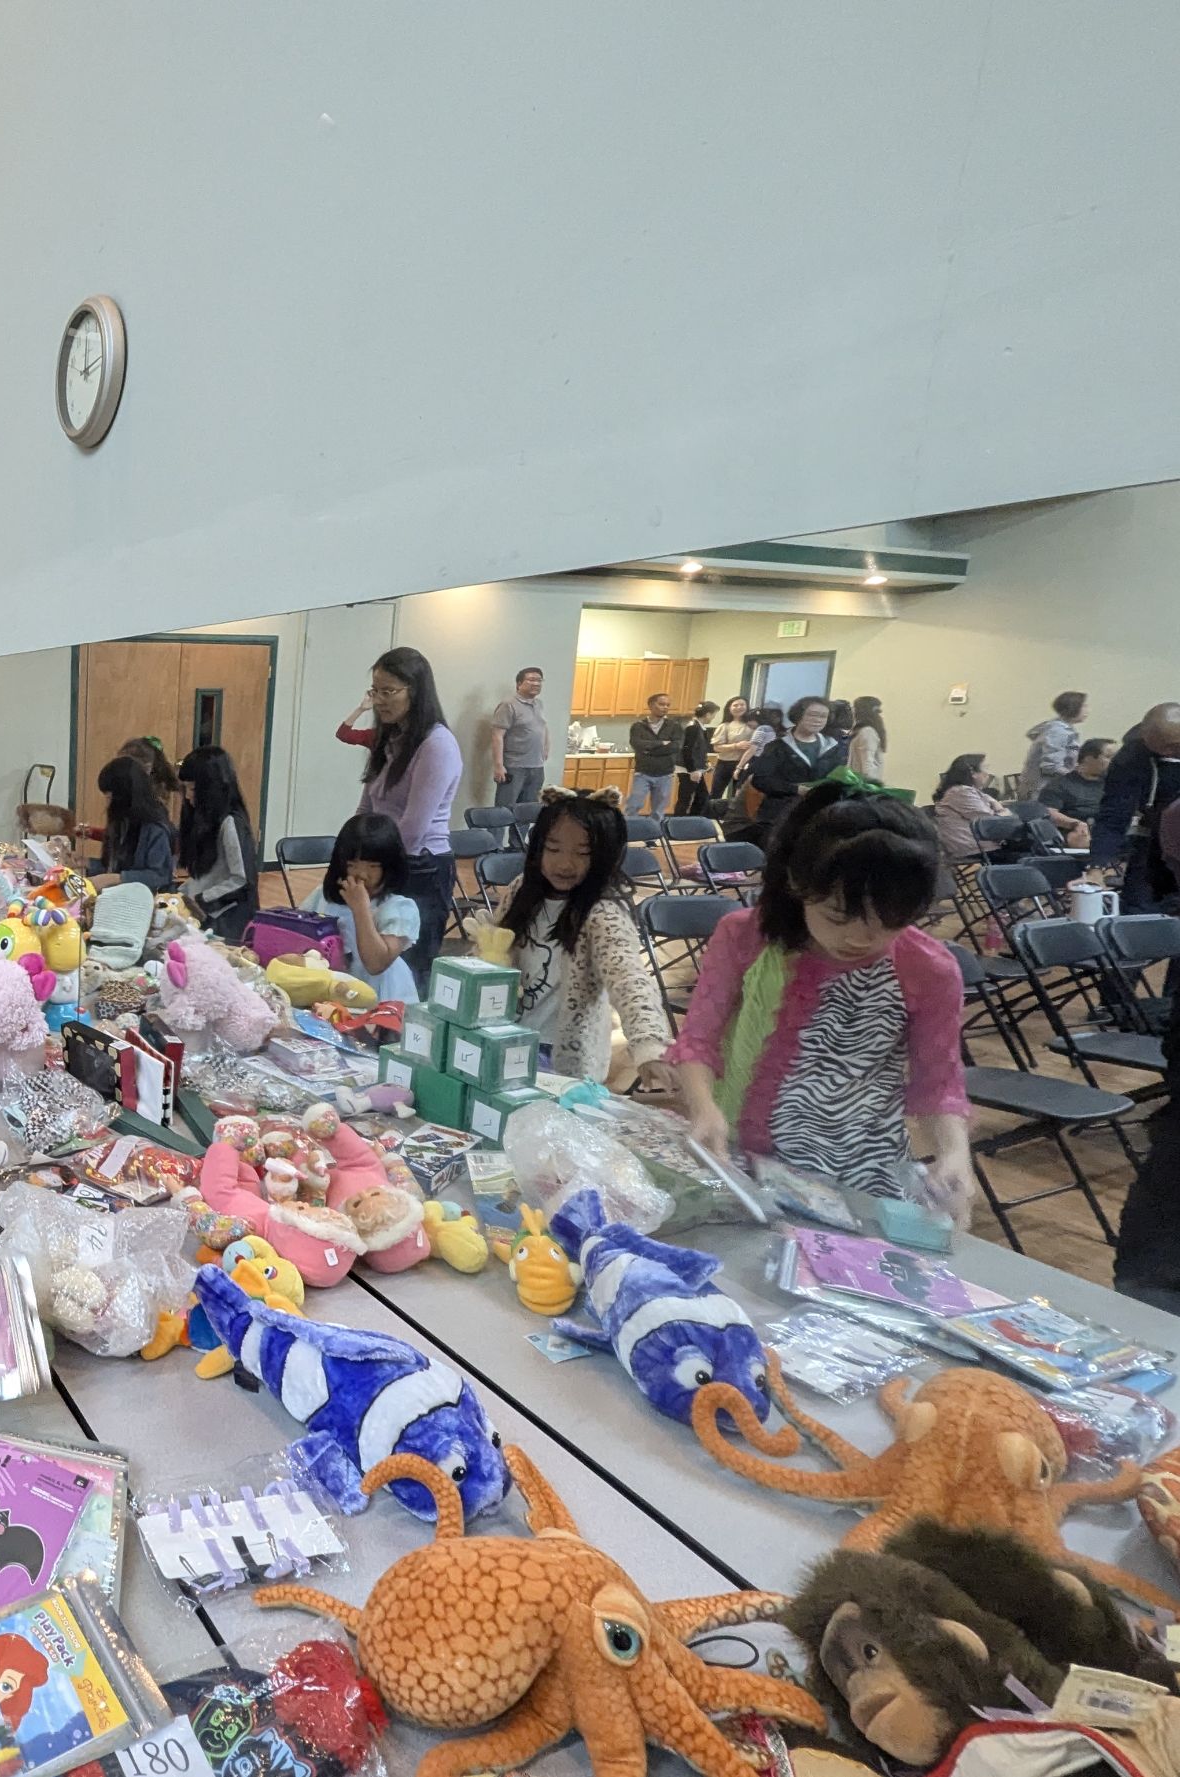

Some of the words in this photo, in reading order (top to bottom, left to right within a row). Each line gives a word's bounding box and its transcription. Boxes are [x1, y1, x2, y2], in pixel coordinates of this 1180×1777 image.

[33, 1610, 58, 1637] Play
[52, 1636, 77, 1668] Pack
[51, 1599, 64, 1617] BOOK
[61, 1616, 69, 1626] TO
[65, 1626, 81, 1649] COLOR
[122, 1737, 191, 1777] 180
